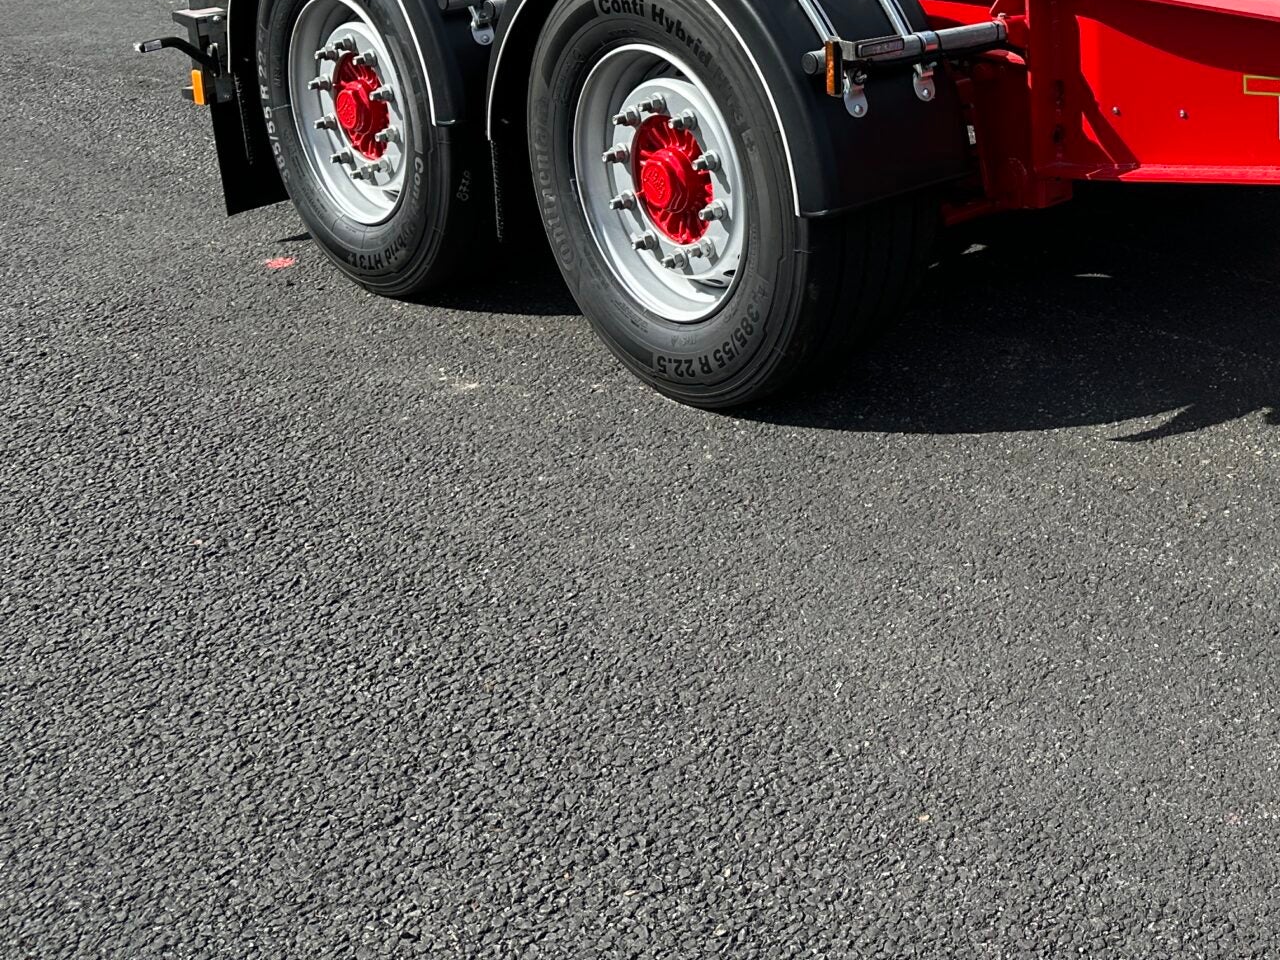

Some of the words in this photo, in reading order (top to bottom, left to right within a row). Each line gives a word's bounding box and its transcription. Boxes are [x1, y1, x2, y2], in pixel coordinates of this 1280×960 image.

[651, 3, 713, 69] Hybrid
[260, 84, 270, 100] R
[263, 106, 291, 183] 385/55
[713, 303, 760, 369] 385/55
[657, 355, 696, 378] 22.5
[699, 355, 713, 375] R
